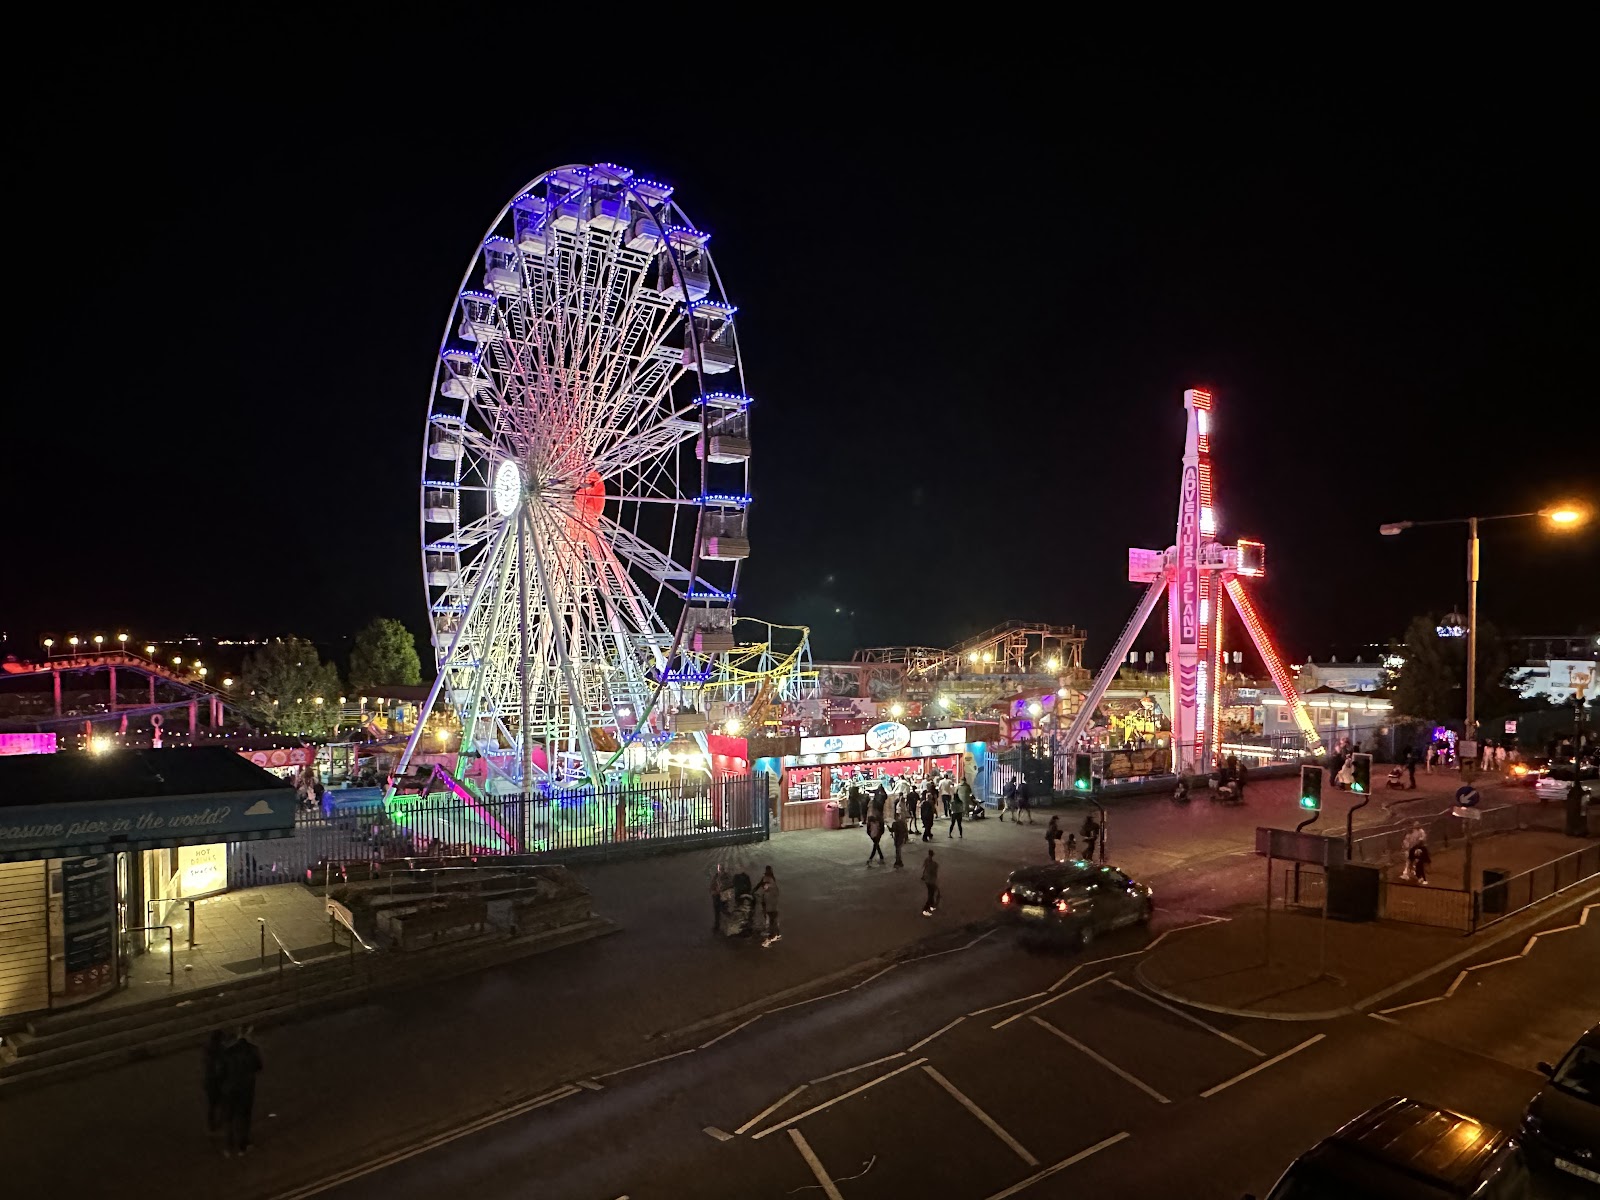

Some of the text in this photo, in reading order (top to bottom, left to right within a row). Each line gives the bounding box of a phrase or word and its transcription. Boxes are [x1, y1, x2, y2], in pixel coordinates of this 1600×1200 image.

[1183, 467, 1197, 639] ADVENTURE ISLAND
[65, 819, 107, 838] pier
[112, 818, 132, 832] in
[137, 811, 166, 831] the
[168, 806, 231, 828] world?
[195, 848, 211, 857] HOT
